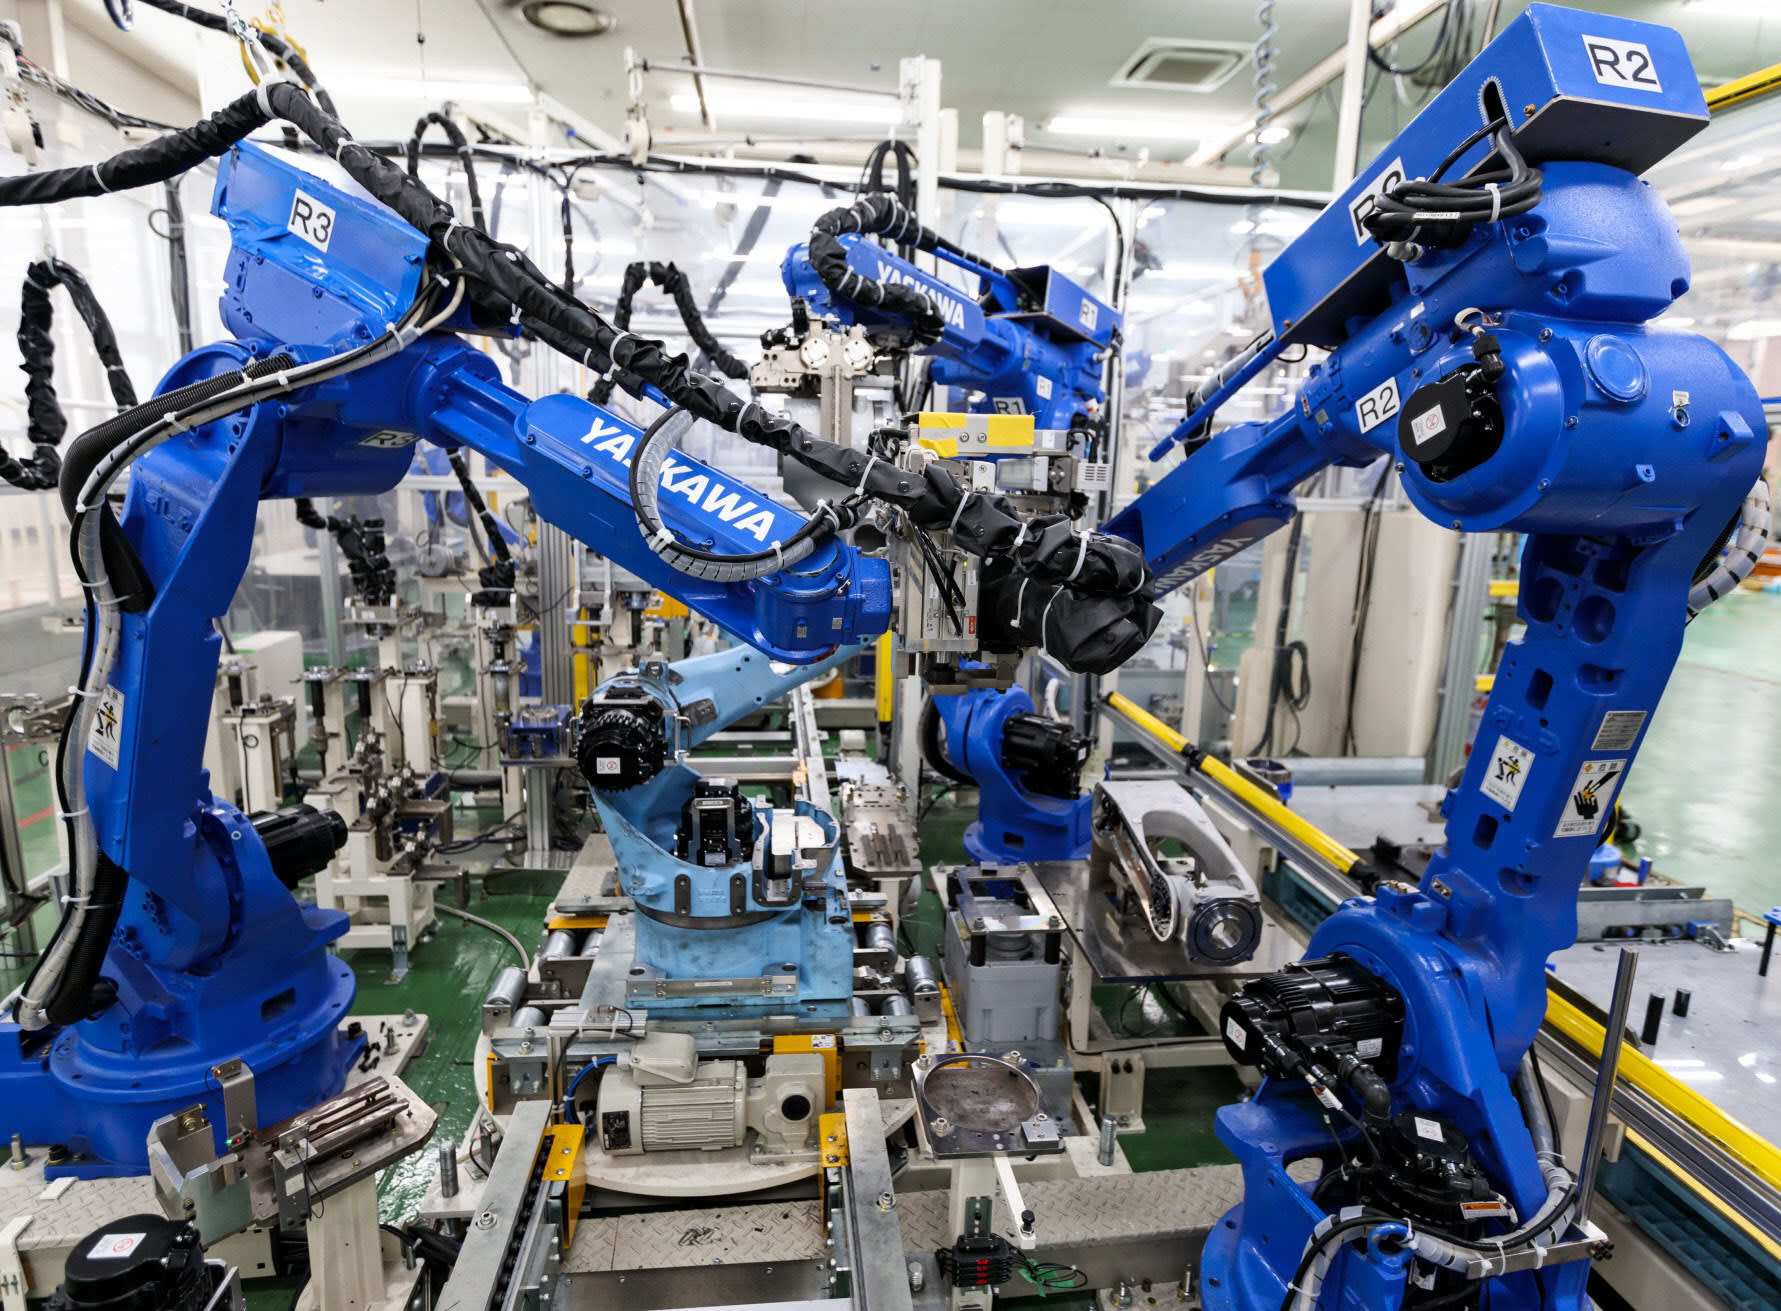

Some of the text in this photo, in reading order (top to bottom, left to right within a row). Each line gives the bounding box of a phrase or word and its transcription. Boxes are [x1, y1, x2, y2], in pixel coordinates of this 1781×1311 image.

[1588, 43, 1657, 84] R2
[291, 197, 331, 243] R3
[1360, 386, 1396, 428] R2
[580, 417, 775, 542] YAKAWA
